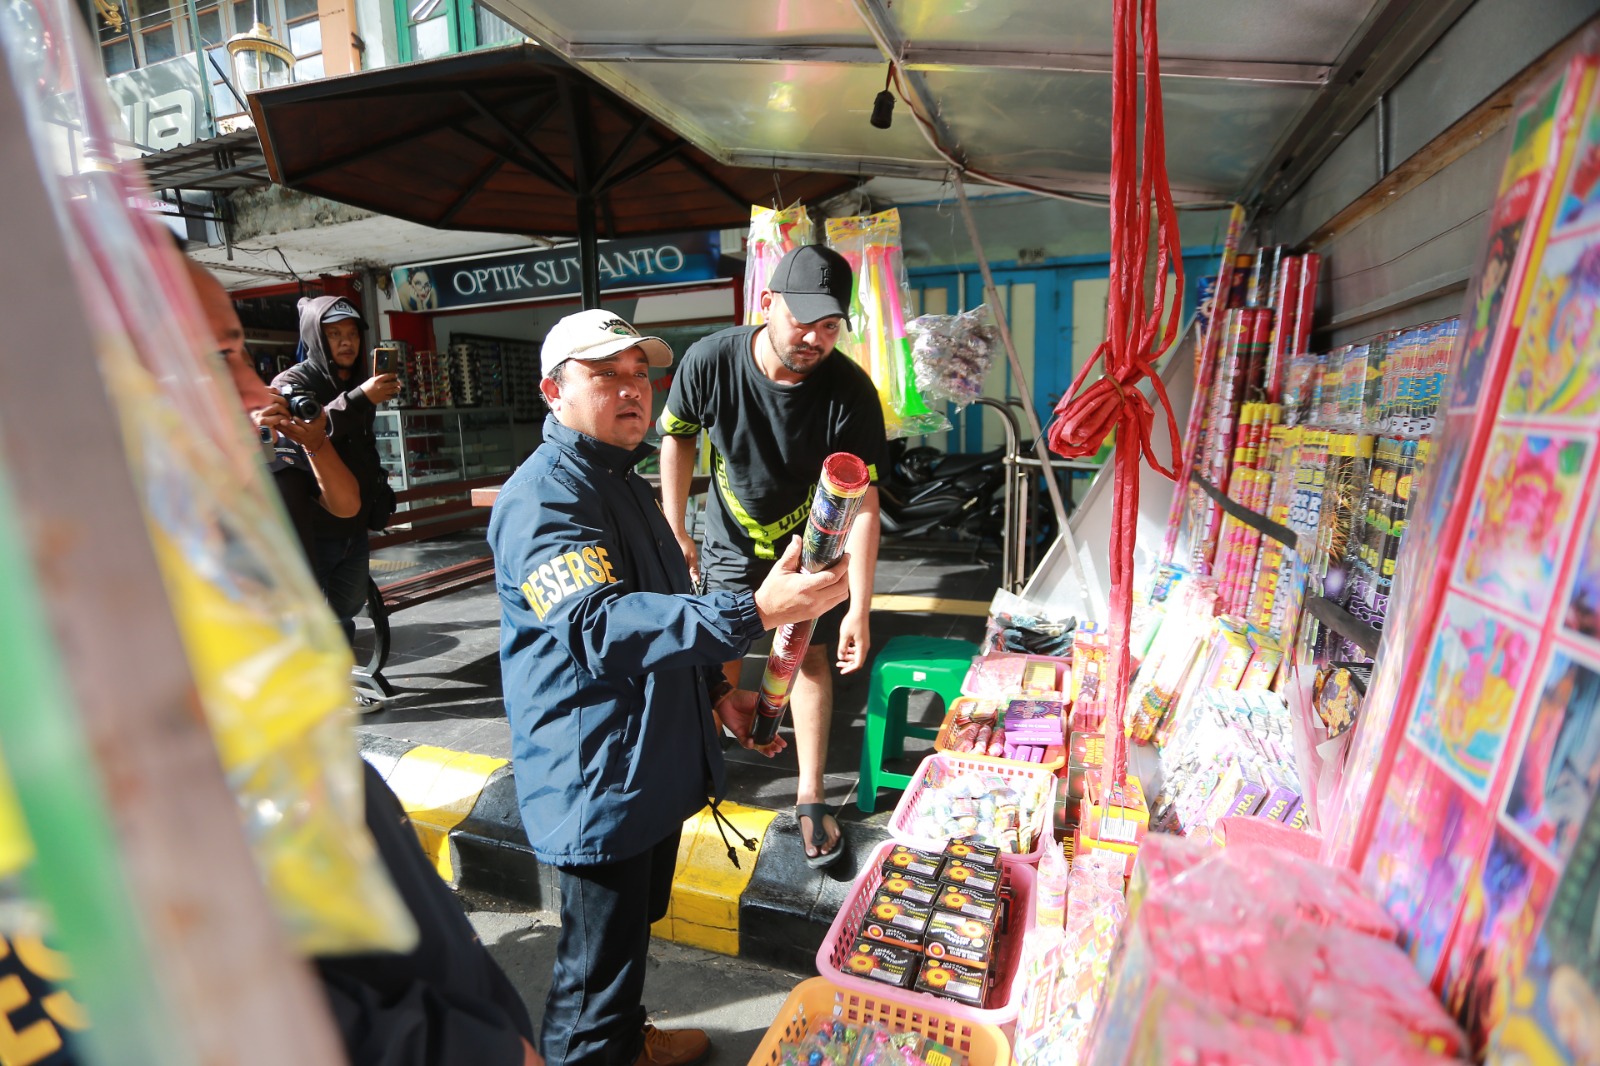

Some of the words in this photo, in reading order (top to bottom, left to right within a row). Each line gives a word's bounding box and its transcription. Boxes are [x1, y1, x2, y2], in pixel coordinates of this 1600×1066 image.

[453, 264, 532, 296] OPTIK
[533, 245, 685, 287] SUANTO
[520, 546, 618, 623] RESERSE
